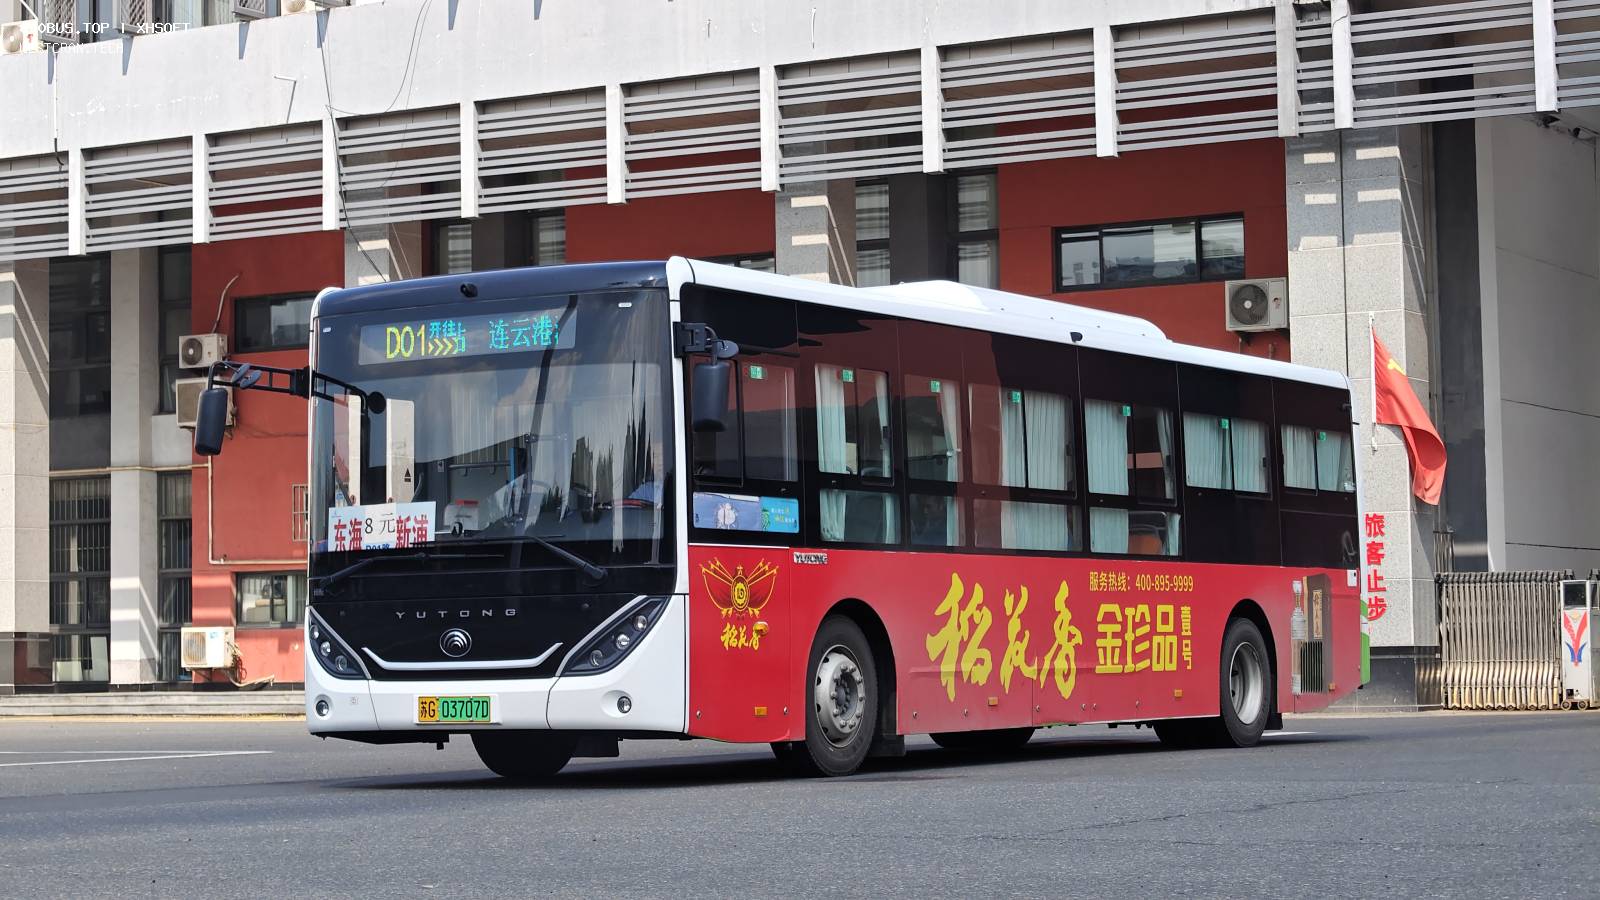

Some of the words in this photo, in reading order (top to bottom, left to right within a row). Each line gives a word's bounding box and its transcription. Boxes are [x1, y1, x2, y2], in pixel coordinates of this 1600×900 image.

[386, 323, 426, 360] D01
[488, 314, 559, 350] 连云港
[334, 518, 363, 551] 东海
[364, 517, 373, 534] 8
[379, 512, 396, 534] 元
[395, 514, 429, 549] 新浦
[1364, 513, 1388, 622] 旅客止步
[396, 606, 517, 620] YUTONG
[926, 572, 1083, 702] 稻花香
[1095, 603, 1178, 674] 金珍品
[1180, 606, 1193, 670] 壹号
